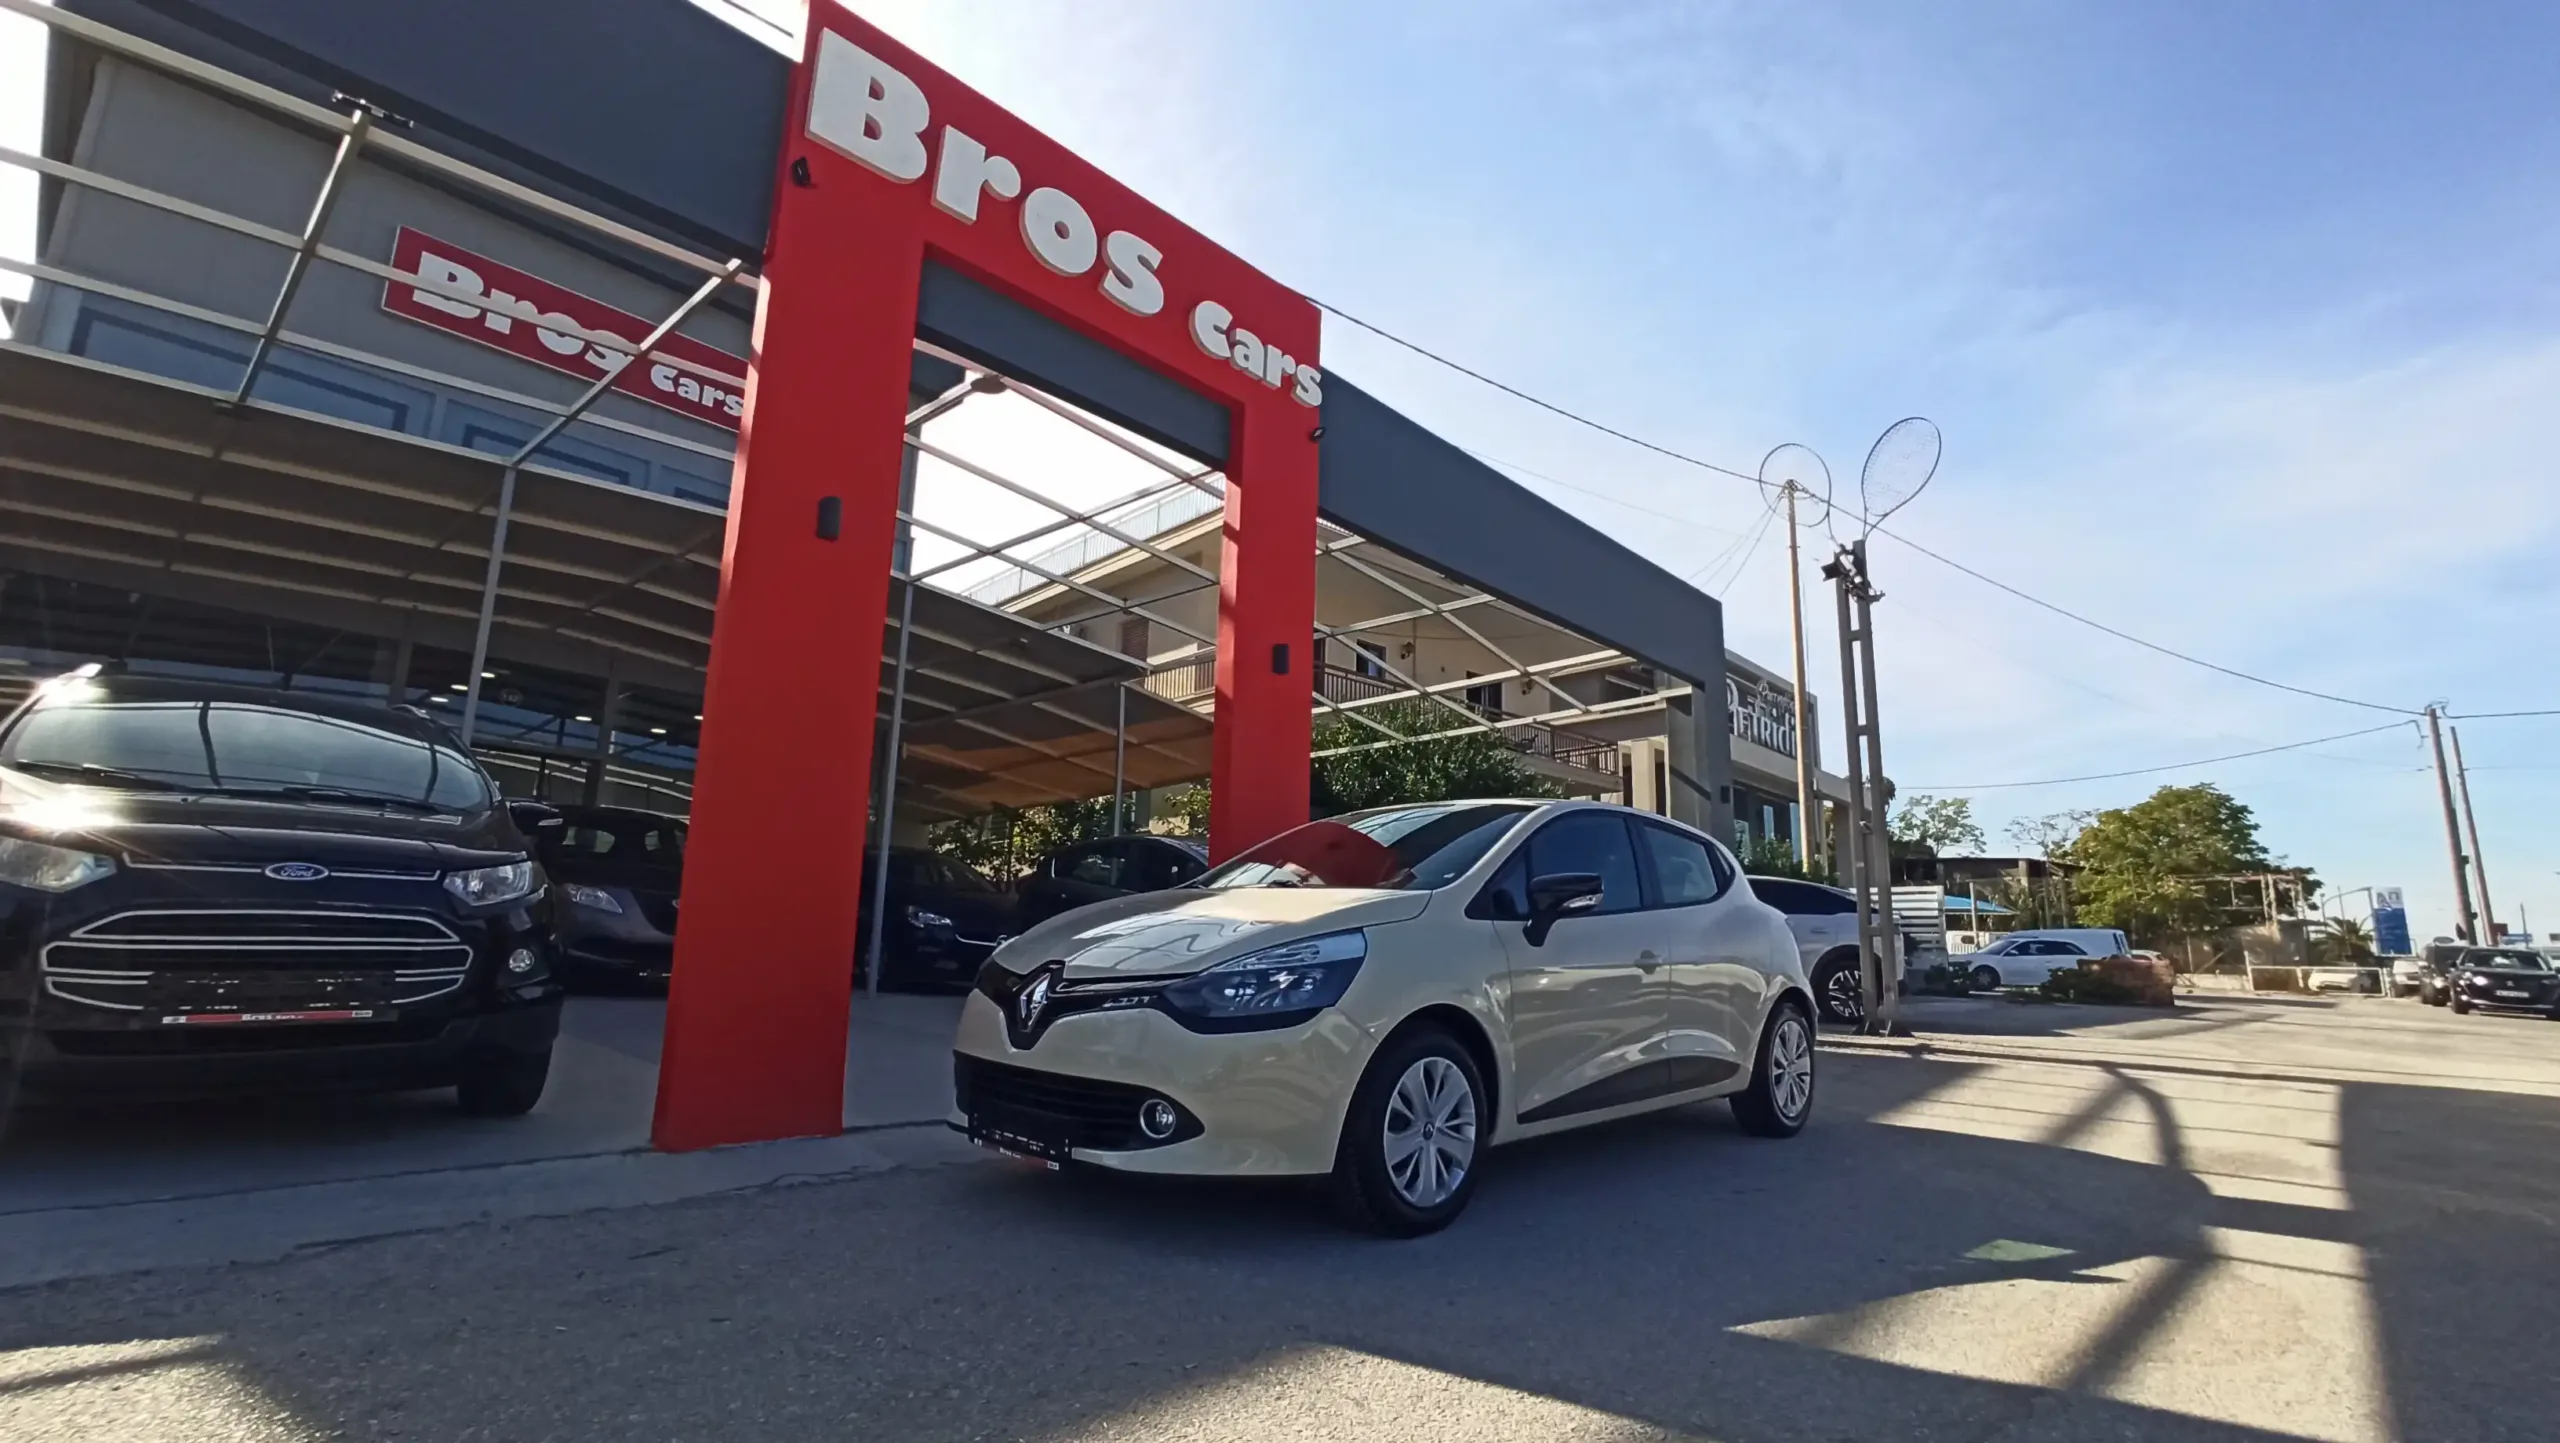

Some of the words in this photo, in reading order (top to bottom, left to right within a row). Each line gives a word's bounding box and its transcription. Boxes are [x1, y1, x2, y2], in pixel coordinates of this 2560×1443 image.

[805, 27, 1164, 317] Bros
[413, 251, 634, 372] Bros
[281, 865, 315, 877] Ford
